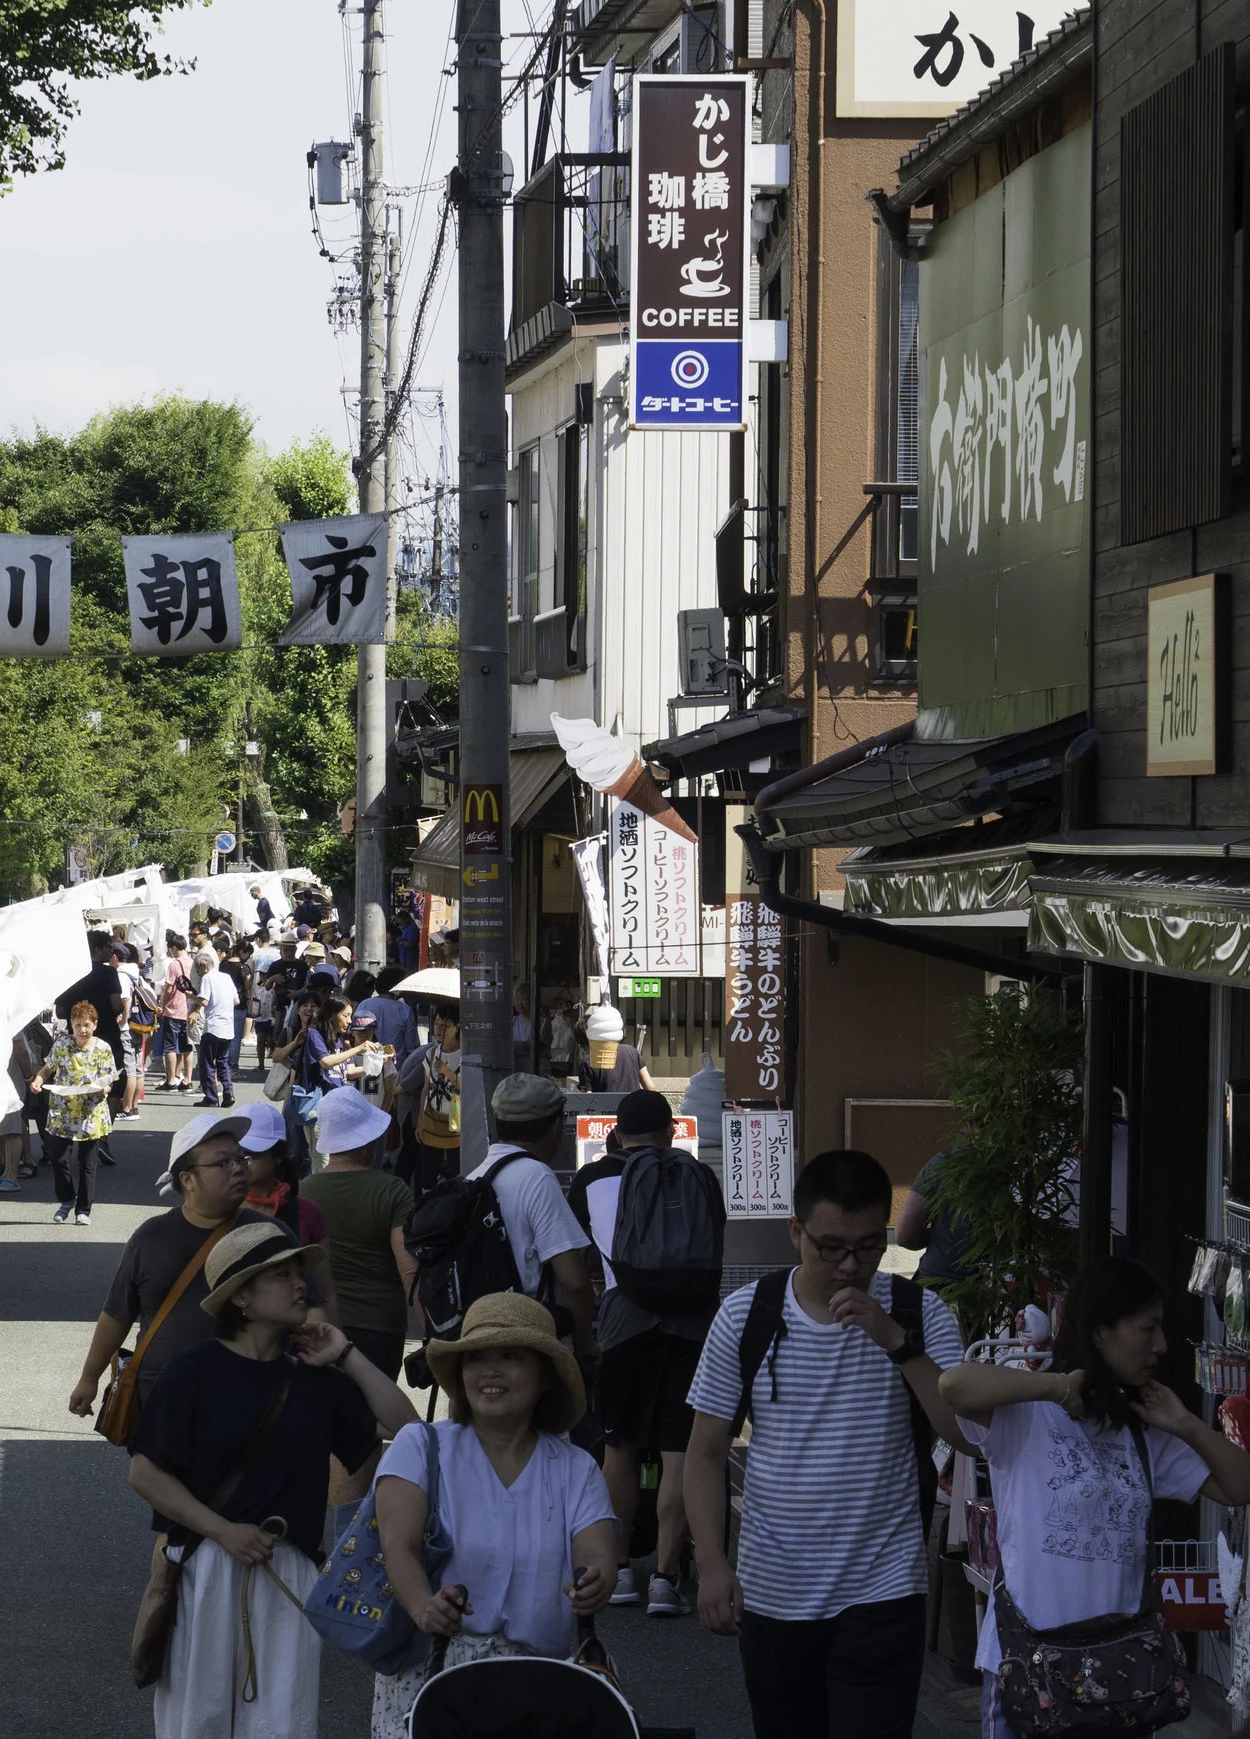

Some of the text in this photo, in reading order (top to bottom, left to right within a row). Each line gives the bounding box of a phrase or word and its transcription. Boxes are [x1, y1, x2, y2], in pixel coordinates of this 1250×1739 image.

[692, 94, 729, 211] かじ橋
[647, 173, 686, 250] 珈琲
[641, 307, 740, 328] COFFEE
[640, 395, 740, 413] ダートコーヒー
[619, 811, 640, 968] 地酒ソフトクリーム
[653, 829, 671, 966] コーヒーソフトクリーム
[671, 845, 689, 966] 桃ソフトクリーム
[730, 900, 755, 1044] 飛騨牛うどん
[756, 900, 782, 1091] 飛騨牛のどんぶり
[730, 1119, 744, 1200] 地酒ソフトクリーム
[750, 1119, 764, 1199] 桃ソフトクリーム
[768, 1136, 782, 1199] ソフトクリーム
[777, 1118, 789, 1155] コーヒー
[325, 1592, 384, 1621] Minion
[1161, 1578, 1225, 1604] ALE
